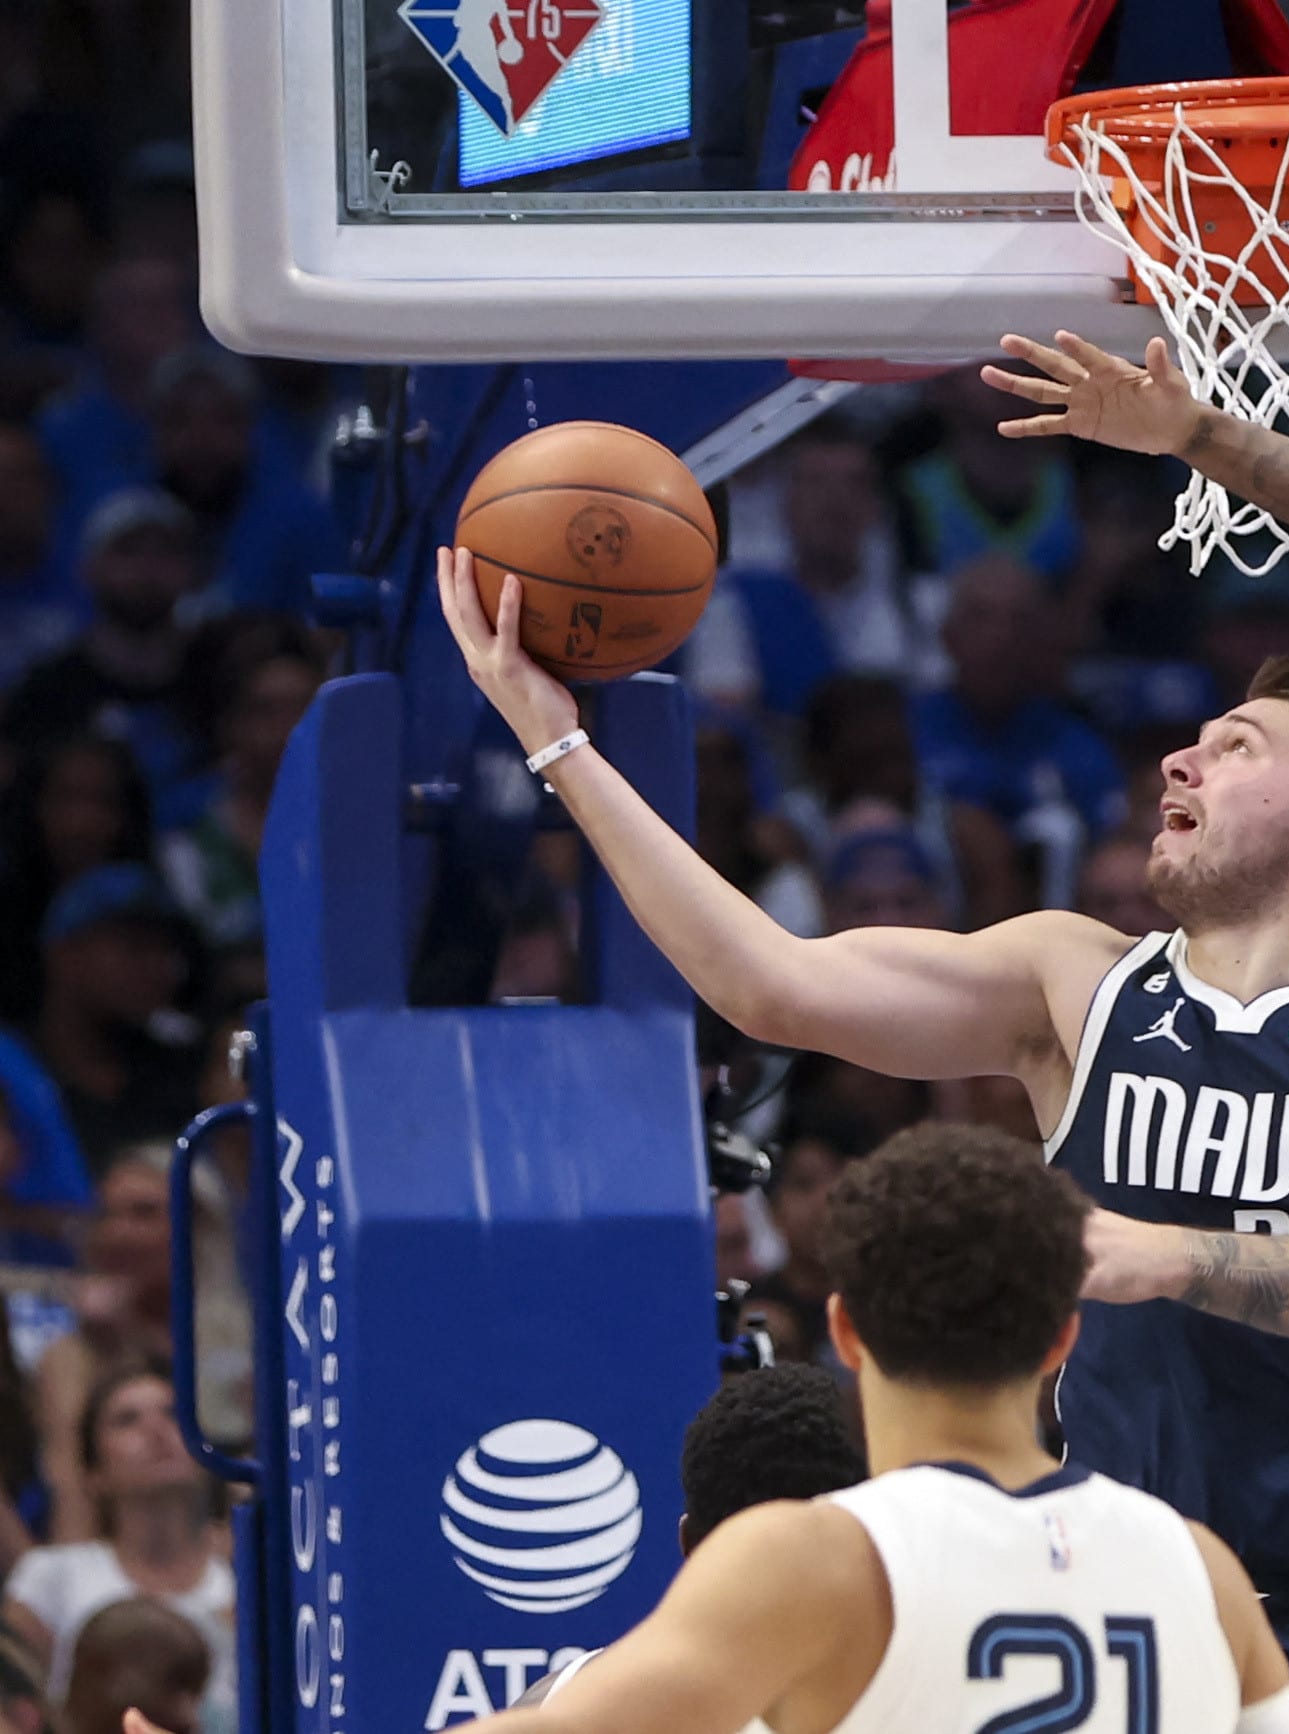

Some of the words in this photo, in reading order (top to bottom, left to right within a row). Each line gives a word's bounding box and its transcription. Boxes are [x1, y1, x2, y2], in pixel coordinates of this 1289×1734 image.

[315, 1154, 342, 1478] RESORTS
[326, 1571, 347, 1734] NOS
[966, 1612, 1160, 1734] 21
